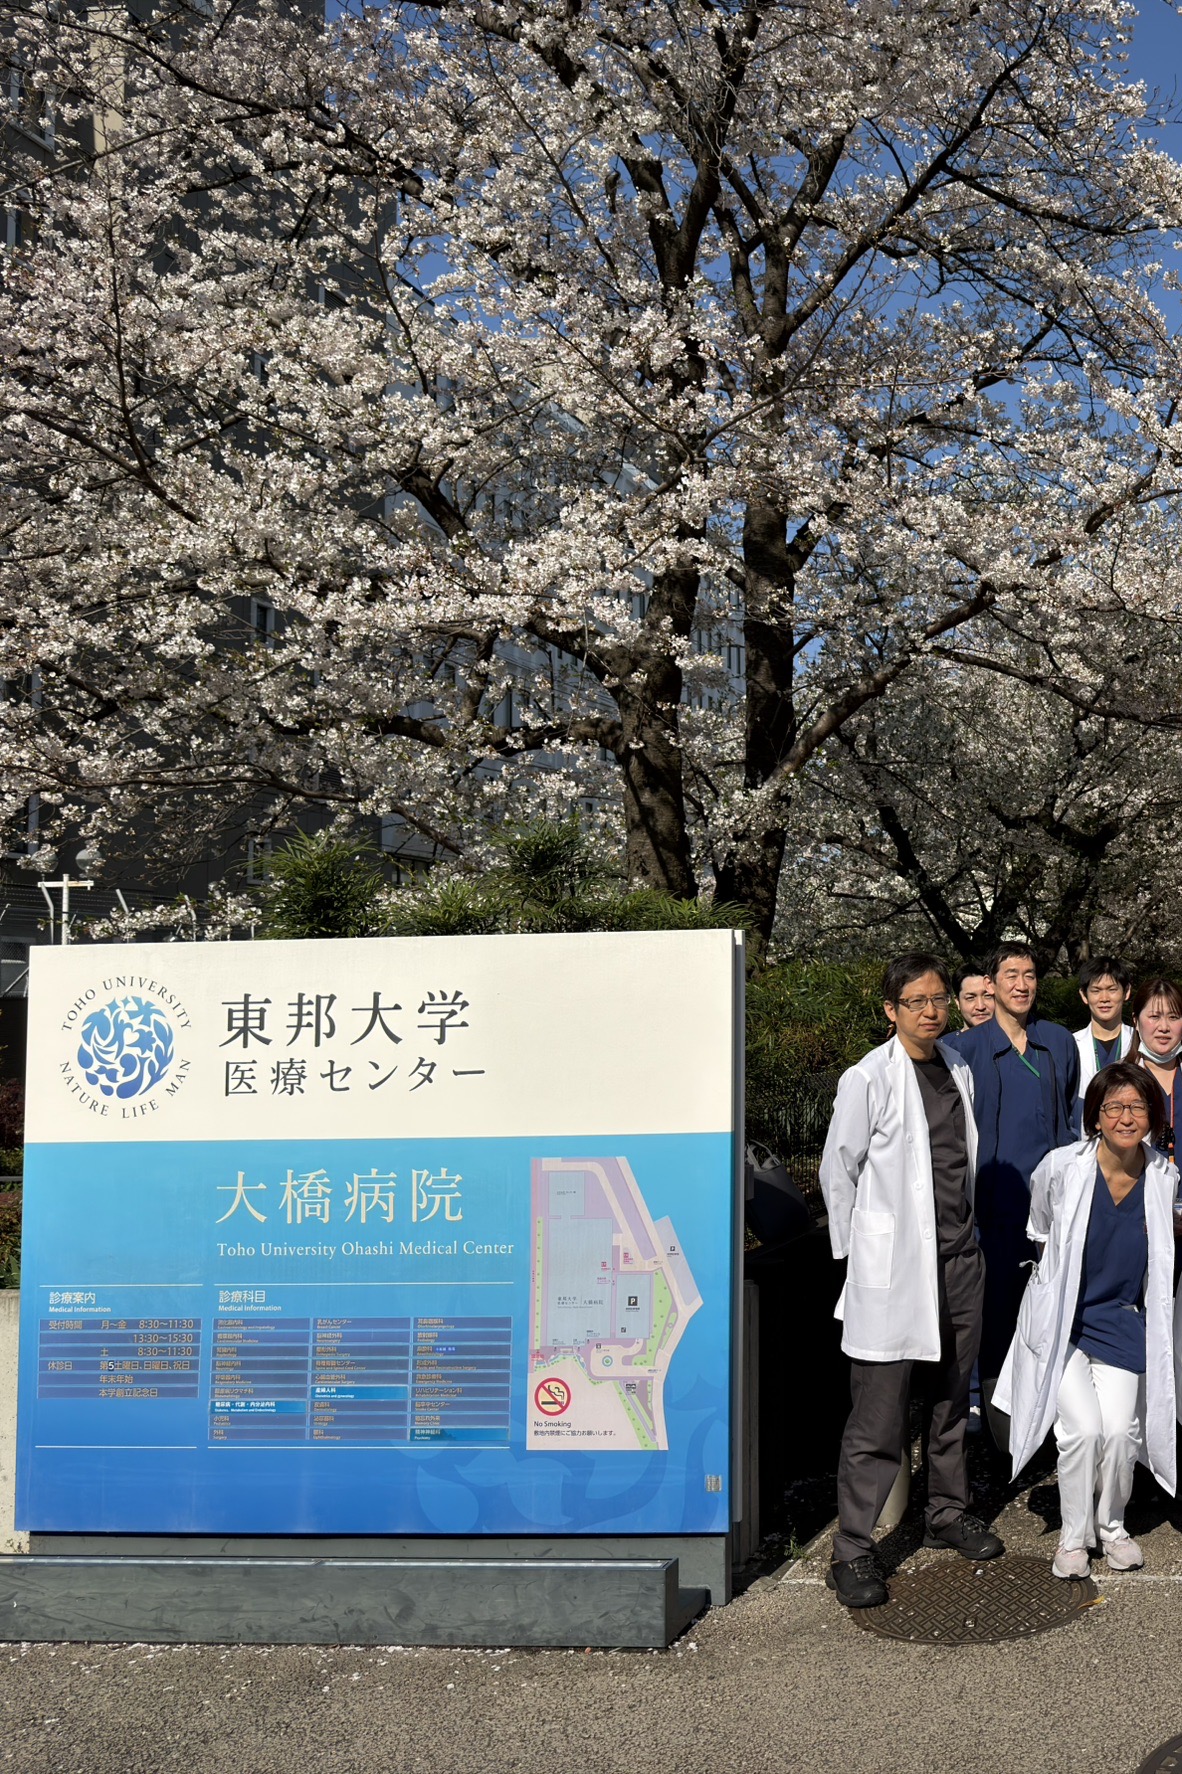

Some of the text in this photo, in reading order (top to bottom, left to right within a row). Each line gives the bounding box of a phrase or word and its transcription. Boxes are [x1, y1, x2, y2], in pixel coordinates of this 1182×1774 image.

[61, 976, 191, 1031] TOHO UNIVERSITY
[219, 990, 469, 1048] 東邦大学
[225, 1057, 485, 1096] 医療センター
[60, 1059, 191, 1118] NATURE LIFE MAN
[215, 1167, 463, 1223] 大橋病院
[217, 1240, 514, 1259] Toho University Ohashi Medical Center
[49, 1292, 96, 1304] 診療案内
[219, 1290, 265, 1303] 診療科目
[49, 1320, 82, 1329] 受付時間
[48, 1361, 72, 1370] 休診日
[99, 1375, 133, 1384] 年末年始
[99, 1388, 158, 1397] 本学創立記念日
